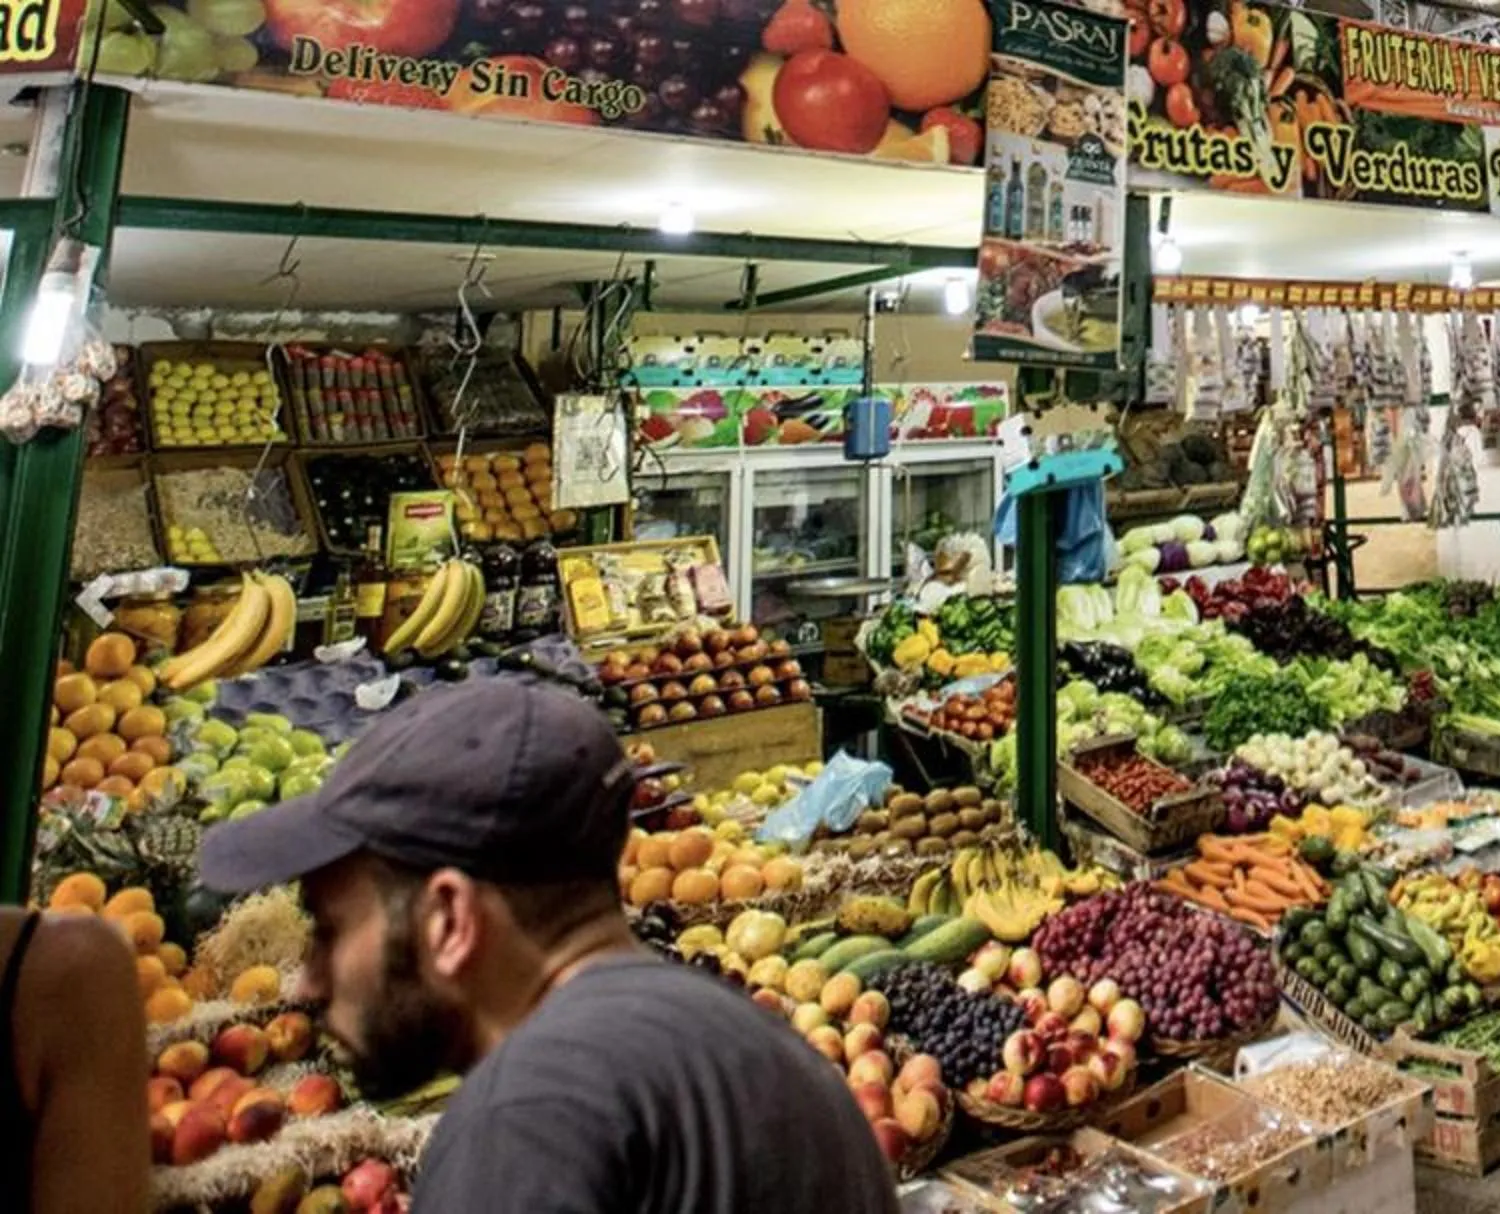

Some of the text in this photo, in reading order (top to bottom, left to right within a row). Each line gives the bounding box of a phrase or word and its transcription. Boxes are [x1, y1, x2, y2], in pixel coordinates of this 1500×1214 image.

[292, 35, 645, 117] Delivery Sin Cargo
[1345, 26, 1456, 94] FRUTERIA
[1459, 46, 1472, 95] Y
[1270, 143, 1295, 190] y
[1307, 125, 1480, 196] Verduras
